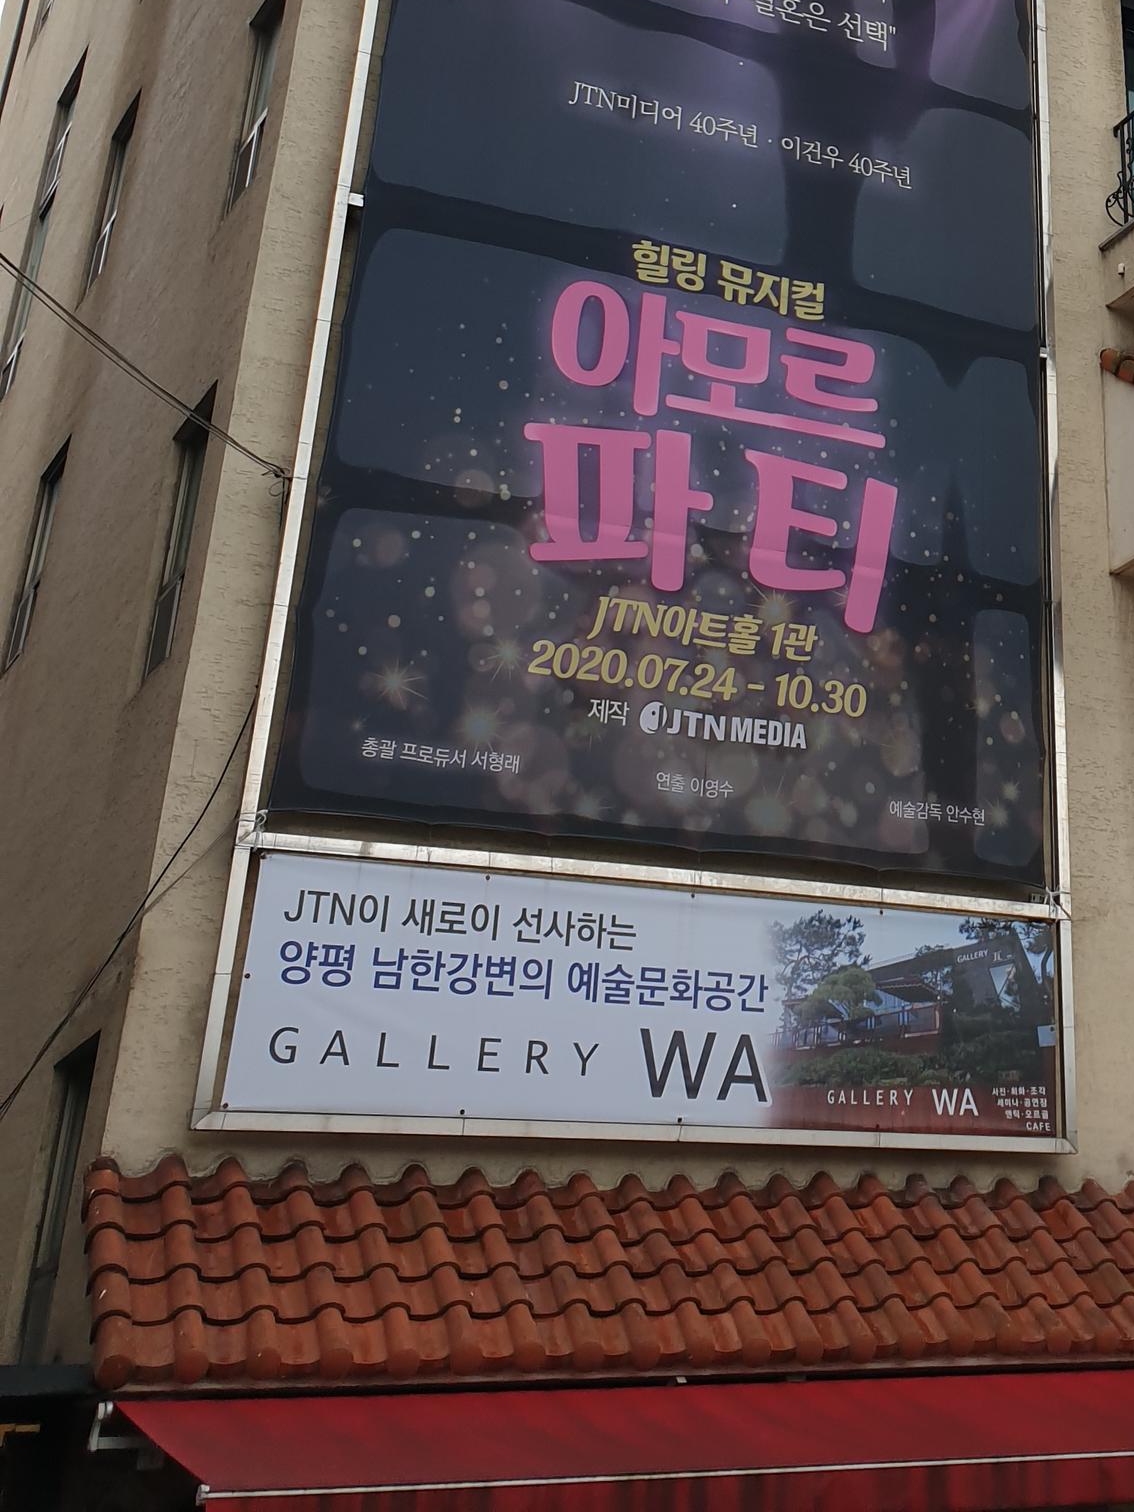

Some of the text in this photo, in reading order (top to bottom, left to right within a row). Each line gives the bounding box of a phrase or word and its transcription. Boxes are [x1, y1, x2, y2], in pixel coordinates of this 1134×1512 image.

[838, 12, 896, 51] 선택"
[569, 80, 913, 190] JTN미디어 40주년 이건우 40주년
[631, 239, 826, 322] 힐링 뮤지컬
[550, 280, 887, 449] 아모르
[523, 421, 898, 634] 파티
[587, 595, 819, 663] JTN아트홀 1관
[527, 639, 868, 719] 2020.07.24 10.30
[361, 736, 521, 774] 총괄 프로듀서 서형래
[587, 697, 807, 750] 제작 JTN MEDIA
[655, 770, 734, 801] 연출 이영수
[888, 797, 986, 827] 예술감독 안수현
[282, 889, 638, 953] JTN이 새로이 선사하는
[279, 938, 770, 1015] 양평 남한강변의 예술문화공간
[957, 949, 988, 963] GALLERY
[268, 1024, 771, 1104] GALLERY WA
[826, 1087, 980, 1118] GALLERY WA
[1026, 1122, 1051, 1132] CAFE
